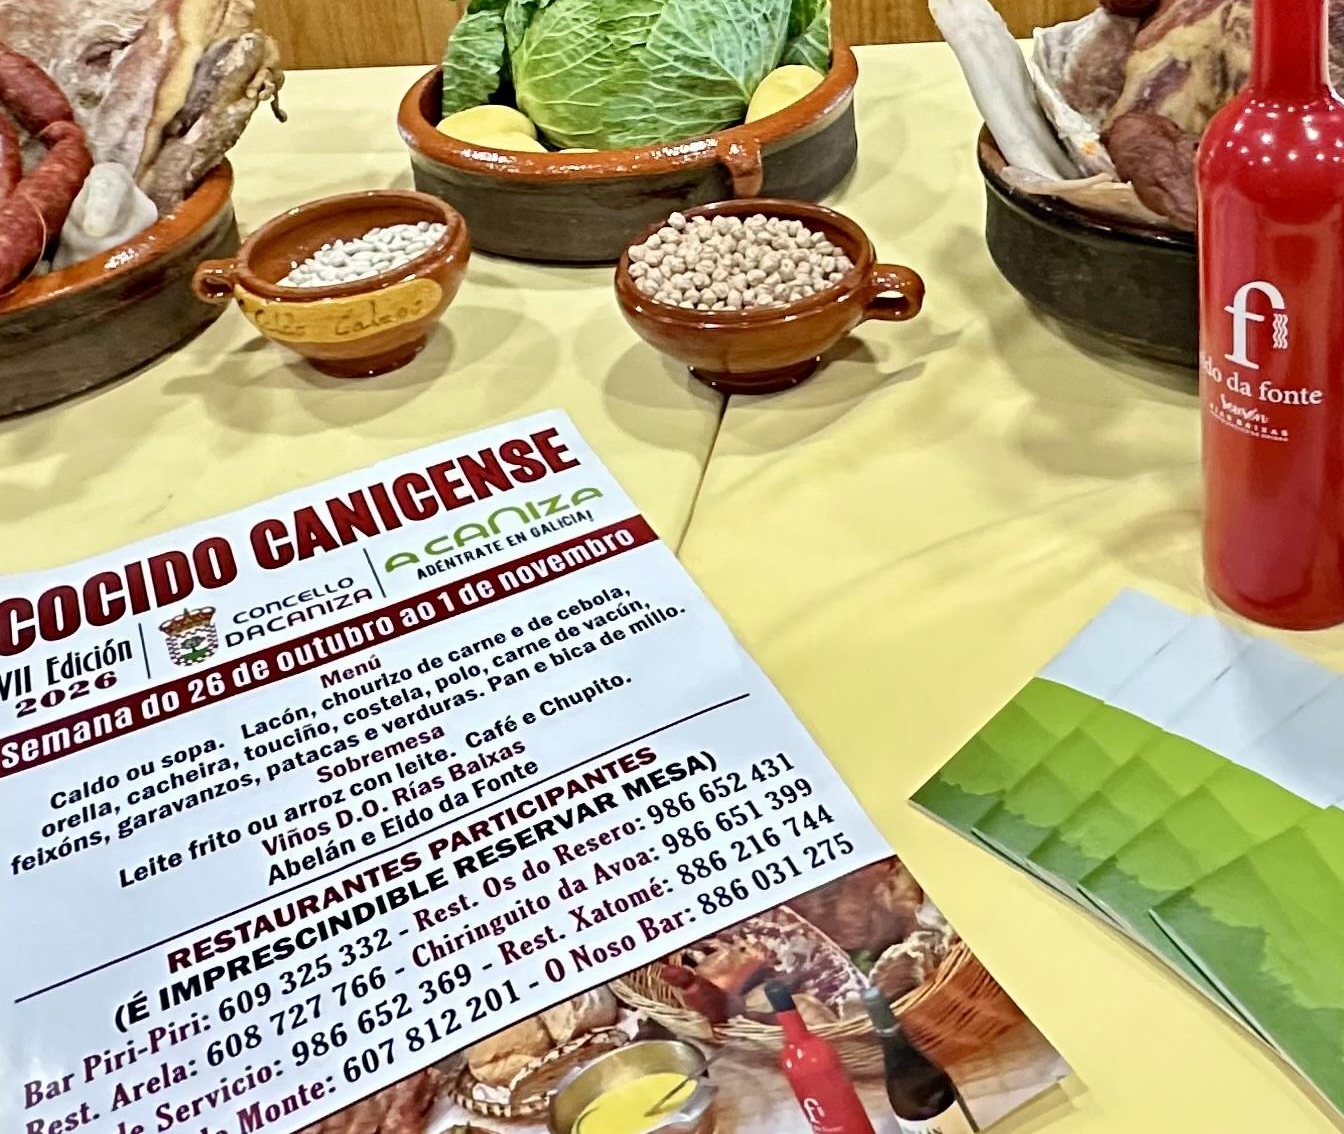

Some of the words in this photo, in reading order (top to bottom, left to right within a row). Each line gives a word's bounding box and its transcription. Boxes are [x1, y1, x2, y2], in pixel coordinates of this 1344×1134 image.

[1227, 372, 1252, 397] da
[1258, 381, 1323, 405] fonte
[231, 576, 354, 625] CONCELLO
[248, 426, 581, 570] CANICENSE
[416, 539, 503, 580] ADÉNTRATE
[504, 530, 528, 547] EN
[0, 705, 133, 769] Semana
[140, 689, 180, 720] do
[186, 671, 226, 704] 26
[275, 615, 395, 672] outubro
[436, 590, 455, 612] 1
[496, 528, 635, 591] novembro
[9, 829, 111, 875] feixóns,
[117, 772, 261, 840] garavanzos,
[265, 733, 360, 782] patacas
[380, 688, 485, 734] verduras.
[486, 666, 530, 692] Pan
[547, 640, 597, 667] bica
[627, 605, 686, 635] millo.
[14, 669, 117, 719] 2026
[40, 800, 121, 838] orella,
[126, 756, 239, 805] cacheira,
[242, 721, 339, 761] touciño,
[342, 686, 431, 725] costela,
[433, 664, 489, 694] polo,
[491, 636, 552, 668] carne
[581, 599, 650, 631] vacún,
[45, 637, 133, 686] Edición
[49, 774, 120, 810] Caldo
[160, 738, 225, 769] sopa.
[239, 706, 317, 740] Lacón,
[320, 667, 413, 711] chourizo
[447, 632, 506, 662] carne
[555, 586, 631, 620] cebola,
[315, 725, 445, 783] Sobremesa
[319, 653, 382, 689] Menú
[118, 851, 183, 888] Leite
[187, 828, 242, 860] frito
[283, 788, 346, 823] arroz
[348, 770, 393, 797] con
[394, 748, 457, 779] leite.
[464, 714, 518, 748] Café
[538, 674, 632, 716] Chupito.
[158, 866, 449, 1012] IMPRESCINDIBLE
[451, 791, 619, 879] RESERVAR
[620, 749, 717, 801] MESA)
[166, 850, 422, 974] RESTAURANTES
[427, 745, 657, 861] PARTICIPANTES
[260, 820, 332, 857] Viños
[334, 798, 389, 829] D.O.
[390, 774, 445, 807] Rías
[446, 739, 526, 782] Baixas
[267, 837, 356, 886] Abelán
[379, 806, 434, 839] Eido
[470, 760, 539, 799] Fonte
[23, 1072, 75, 1110] Bar
[82, 1011, 211, 1084] Piri-Piri:
[217, 981, 271, 1022] 609
[278, 952, 333, 995] 325
[337, 926, 393, 967] 332
[411, 893, 479, 932] Rest.
[481, 875, 517, 898] Os
[551, 816, 646, 866] Resero:
[645, 790, 696, 825] 986
[697, 771, 748, 803] 652
[750, 751, 795, 783] 431
[25, 1101, 100, 1134] Rest.
[110, 1058, 198, 1112] Arela:
[411, 894, 551, 968] Chiringuito
[592, 846, 660, 885] Avoa:
[154, 1058, 284, 1133] Servicio:
[496, 924, 566, 966] Rest.
[566, 875, 674, 933] Xatomé:
[235, 1074, 336, 1134] Monte:
[567, 934, 636, 973] Noso
[635, 907, 697, 943] Bar:
[696, 877, 749, 915] 886
[750, 854, 802, 891] 031
[801, 831, 854, 869] 275
